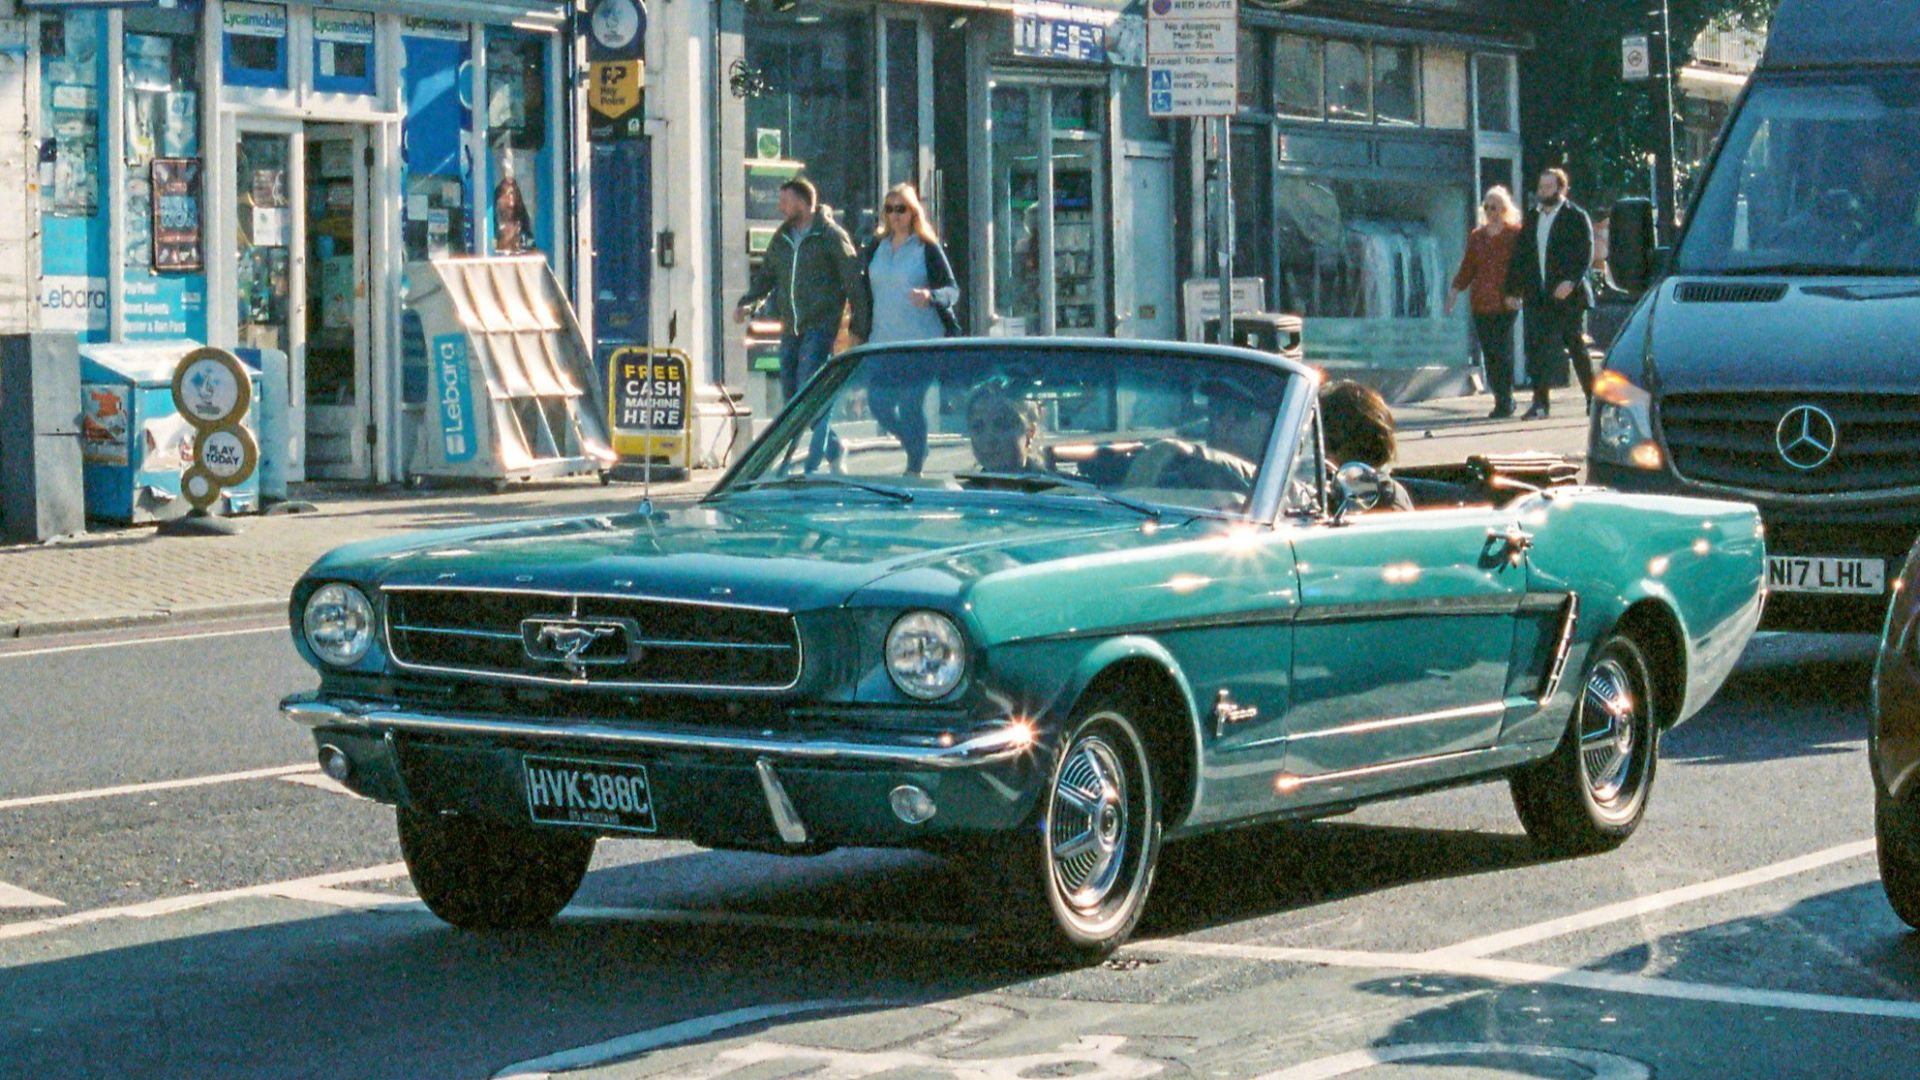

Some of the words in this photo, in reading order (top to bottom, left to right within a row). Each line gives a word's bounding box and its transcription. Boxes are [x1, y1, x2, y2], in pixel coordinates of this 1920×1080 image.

[1174, 0, 1195, 8] RED
[1199, 0, 1232, 9] ROUTE
[223, 13, 285, 28] Lycamobile
[314, 19, 373, 34] Lycamobile
[1181, 23, 1221, 31] stopping
[600, 87, 617, 97] Pay
[600, 95, 625, 105] Point
[1205, 98, 1232, 106] hours
[624, 364, 680, 380] FREE
[440, 343, 463, 433] Lebara
[625, 381, 681, 397] CASH
[623, 409, 680, 425] HERE
[208, 445, 236, 455] PLAY
[206, 453, 240, 466] TODAY
[1768, 558, 1810, 586] N17
[1818, 561, 1873, 588] LHL
[529, 768, 649, 813] HVK388C
